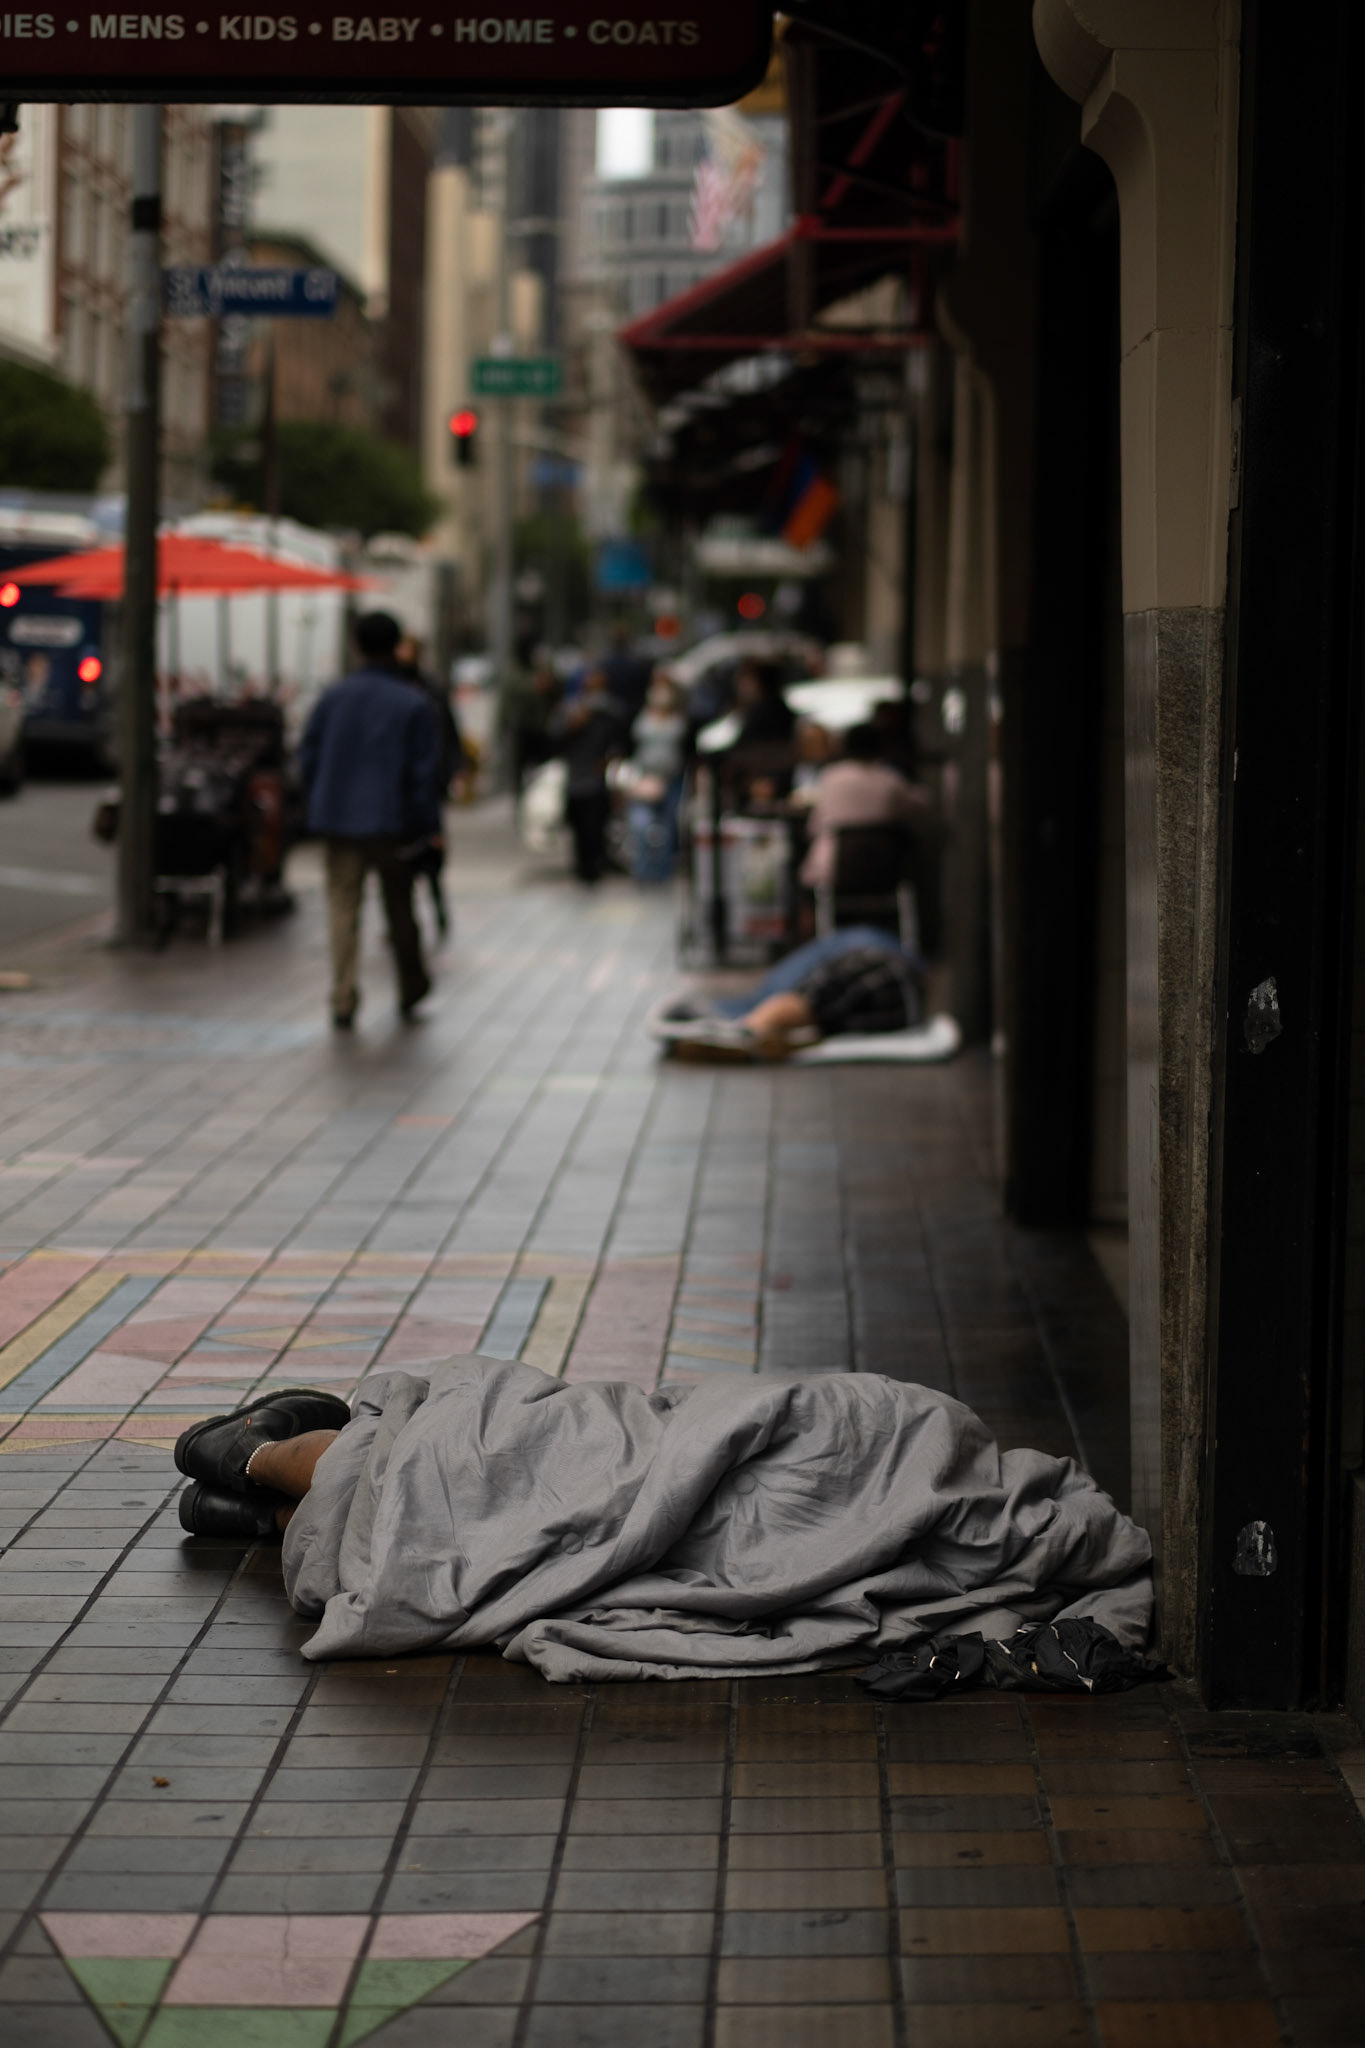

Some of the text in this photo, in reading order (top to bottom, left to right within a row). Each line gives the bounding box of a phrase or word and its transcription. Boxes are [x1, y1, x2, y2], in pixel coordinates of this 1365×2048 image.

[0, 13, 700, 45] IES MENS KIDS BABY HOME COATS
